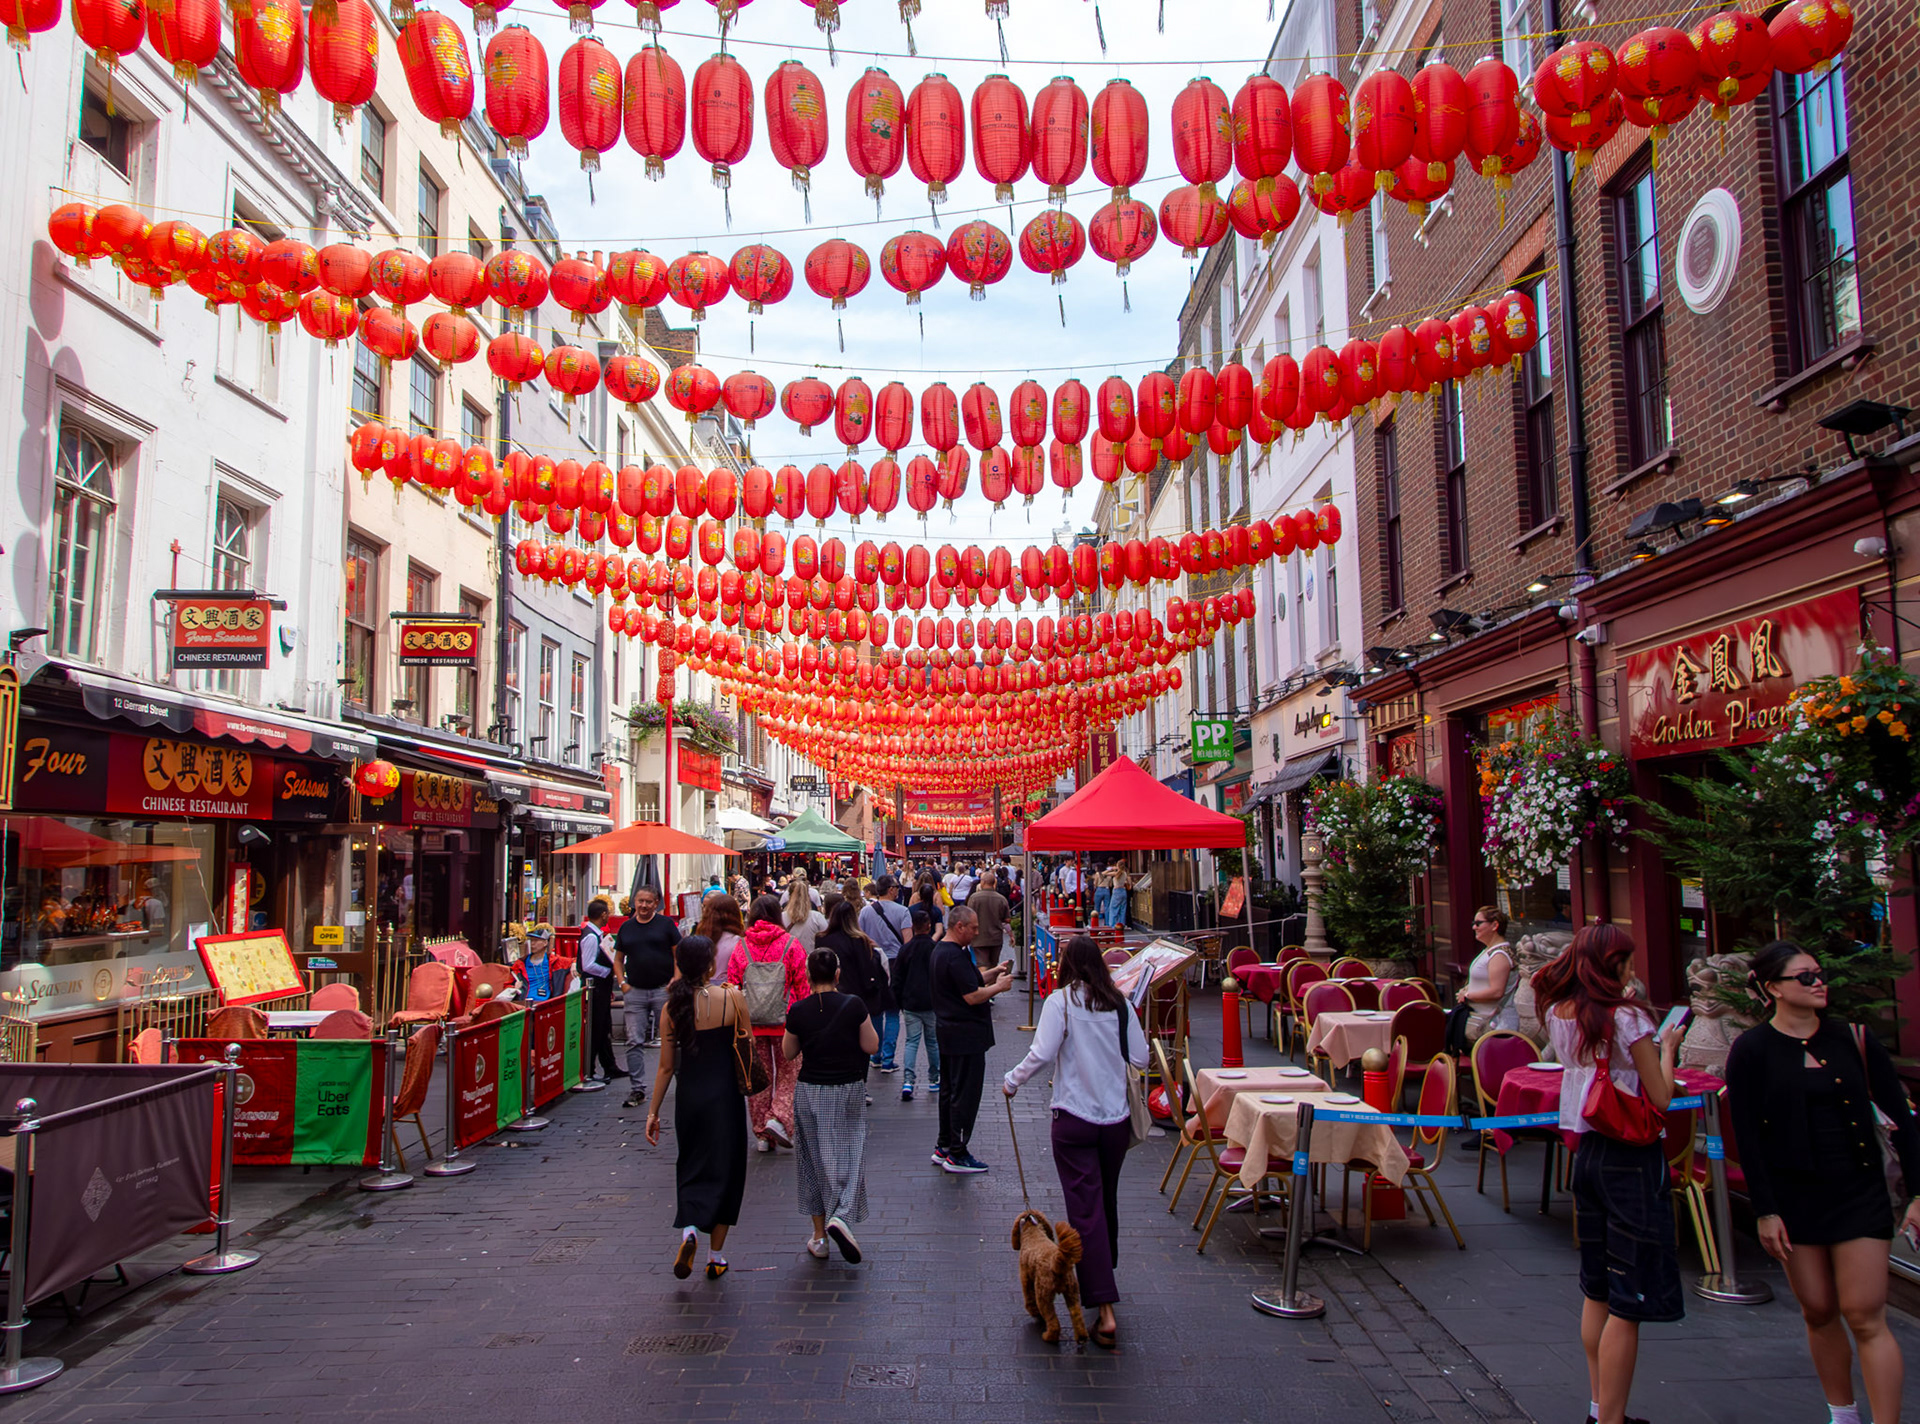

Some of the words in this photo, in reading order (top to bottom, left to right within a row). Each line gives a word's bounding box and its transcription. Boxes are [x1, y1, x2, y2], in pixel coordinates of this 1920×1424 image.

[183, 608, 260, 627] 文興酒家
[185, 630, 213, 644] Four
[213, 630, 258, 643] Seasons
[406, 633, 470, 648] 文興酒家
[178, 653, 211, 662] CHINESE
[212, 653, 262, 662] RESTAURANT
[431, 657, 470, 665] RESTAURANT
[1671, 619, 1784, 704] 金鳳凰
[114, 697, 123, 709] 12
[123, 700, 149, 714] Gerrard
[149, 704, 169, 718] Street
[1652, 709, 1713, 744] Golden
[1725, 697, 1790, 743] Phoen
[23, 738, 87, 783] Four
[147, 739, 248, 789] 文興酒家
[281, 770, 329, 800] Seasons
[142, 796, 186, 812] CHINESE
[189, 799, 249, 815] RESTAURANT
[413, 810, 433, 822] CHINESE
[318, 1090, 350, 1103] Uber
[234, 1107, 280, 1121] Seasons
[317, 1104, 350, 1117] Eats
